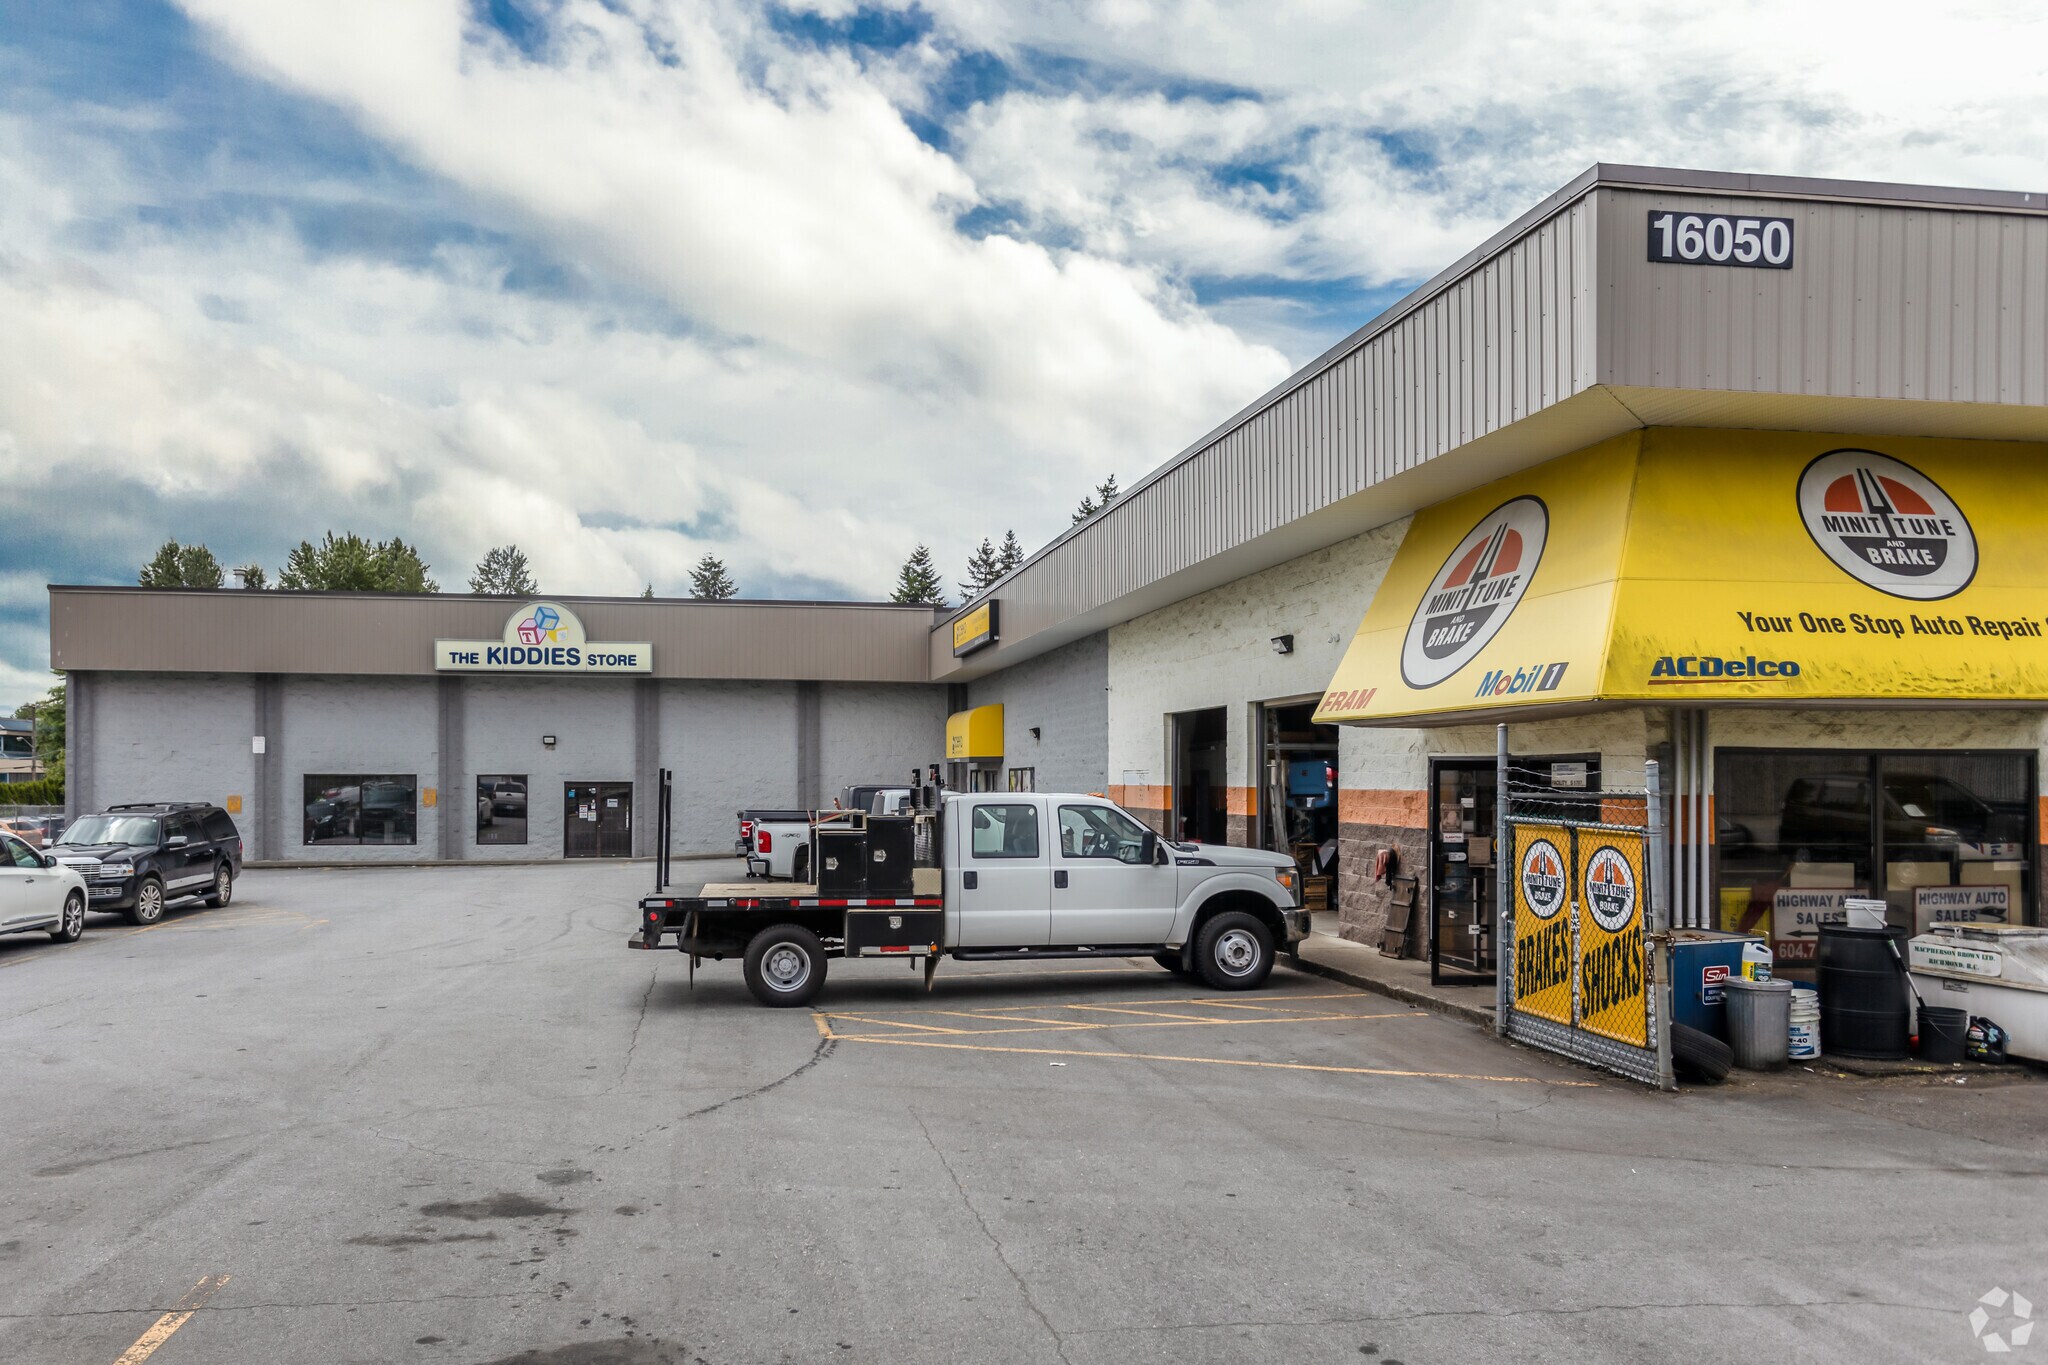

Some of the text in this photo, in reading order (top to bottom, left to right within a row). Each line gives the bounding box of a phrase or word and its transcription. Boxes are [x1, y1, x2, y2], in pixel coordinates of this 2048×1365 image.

[1653, 213, 1790, 265] 16050
[1821, 515, 1956, 537] MINIT TUNE
[1886, 540, 1905, 548] AND
[1866, 547, 1936, 566] BRAKE
[1425, 575, 1520, 616] MINIT TUNE
[1450, 614, 1466, 625] AND
[1737, 611, 1794, 633] Your
[1799, 612, 1847, 634] One
[1849, 613, 1905, 639] Stop
[1910, 614, 1964, 636] Auto
[1965, 615, 2042, 641] Repair
[1425, 621, 1476, 648] BRAKE
[449, 646, 637, 666] THE KIDDIES STORE
[1650, 656, 1800, 677] ACDelco
[1475, 664, 1561, 697] Mobil 1
[1319, 688, 1377, 713] FRAM
[1544, 875, 1561, 887] TUNE
[1600, 901, 1620, 912] BRAKE
[1777, 895, 1833, 907] HIGHWAY
[1919, 891, 2006, 905] HIGHWAY AUTO
[1936, 909, 1977, 922] SALES
[1518, 917, 1568, 1000] BRAKES
[1914, 946, 1956, 957] MACPHERSON
[1957, 951, 1980, 959] BROWN
[1582, 925, 1641, 1020] SHOCKS
[1705, 970, 1727, 982] Sun
